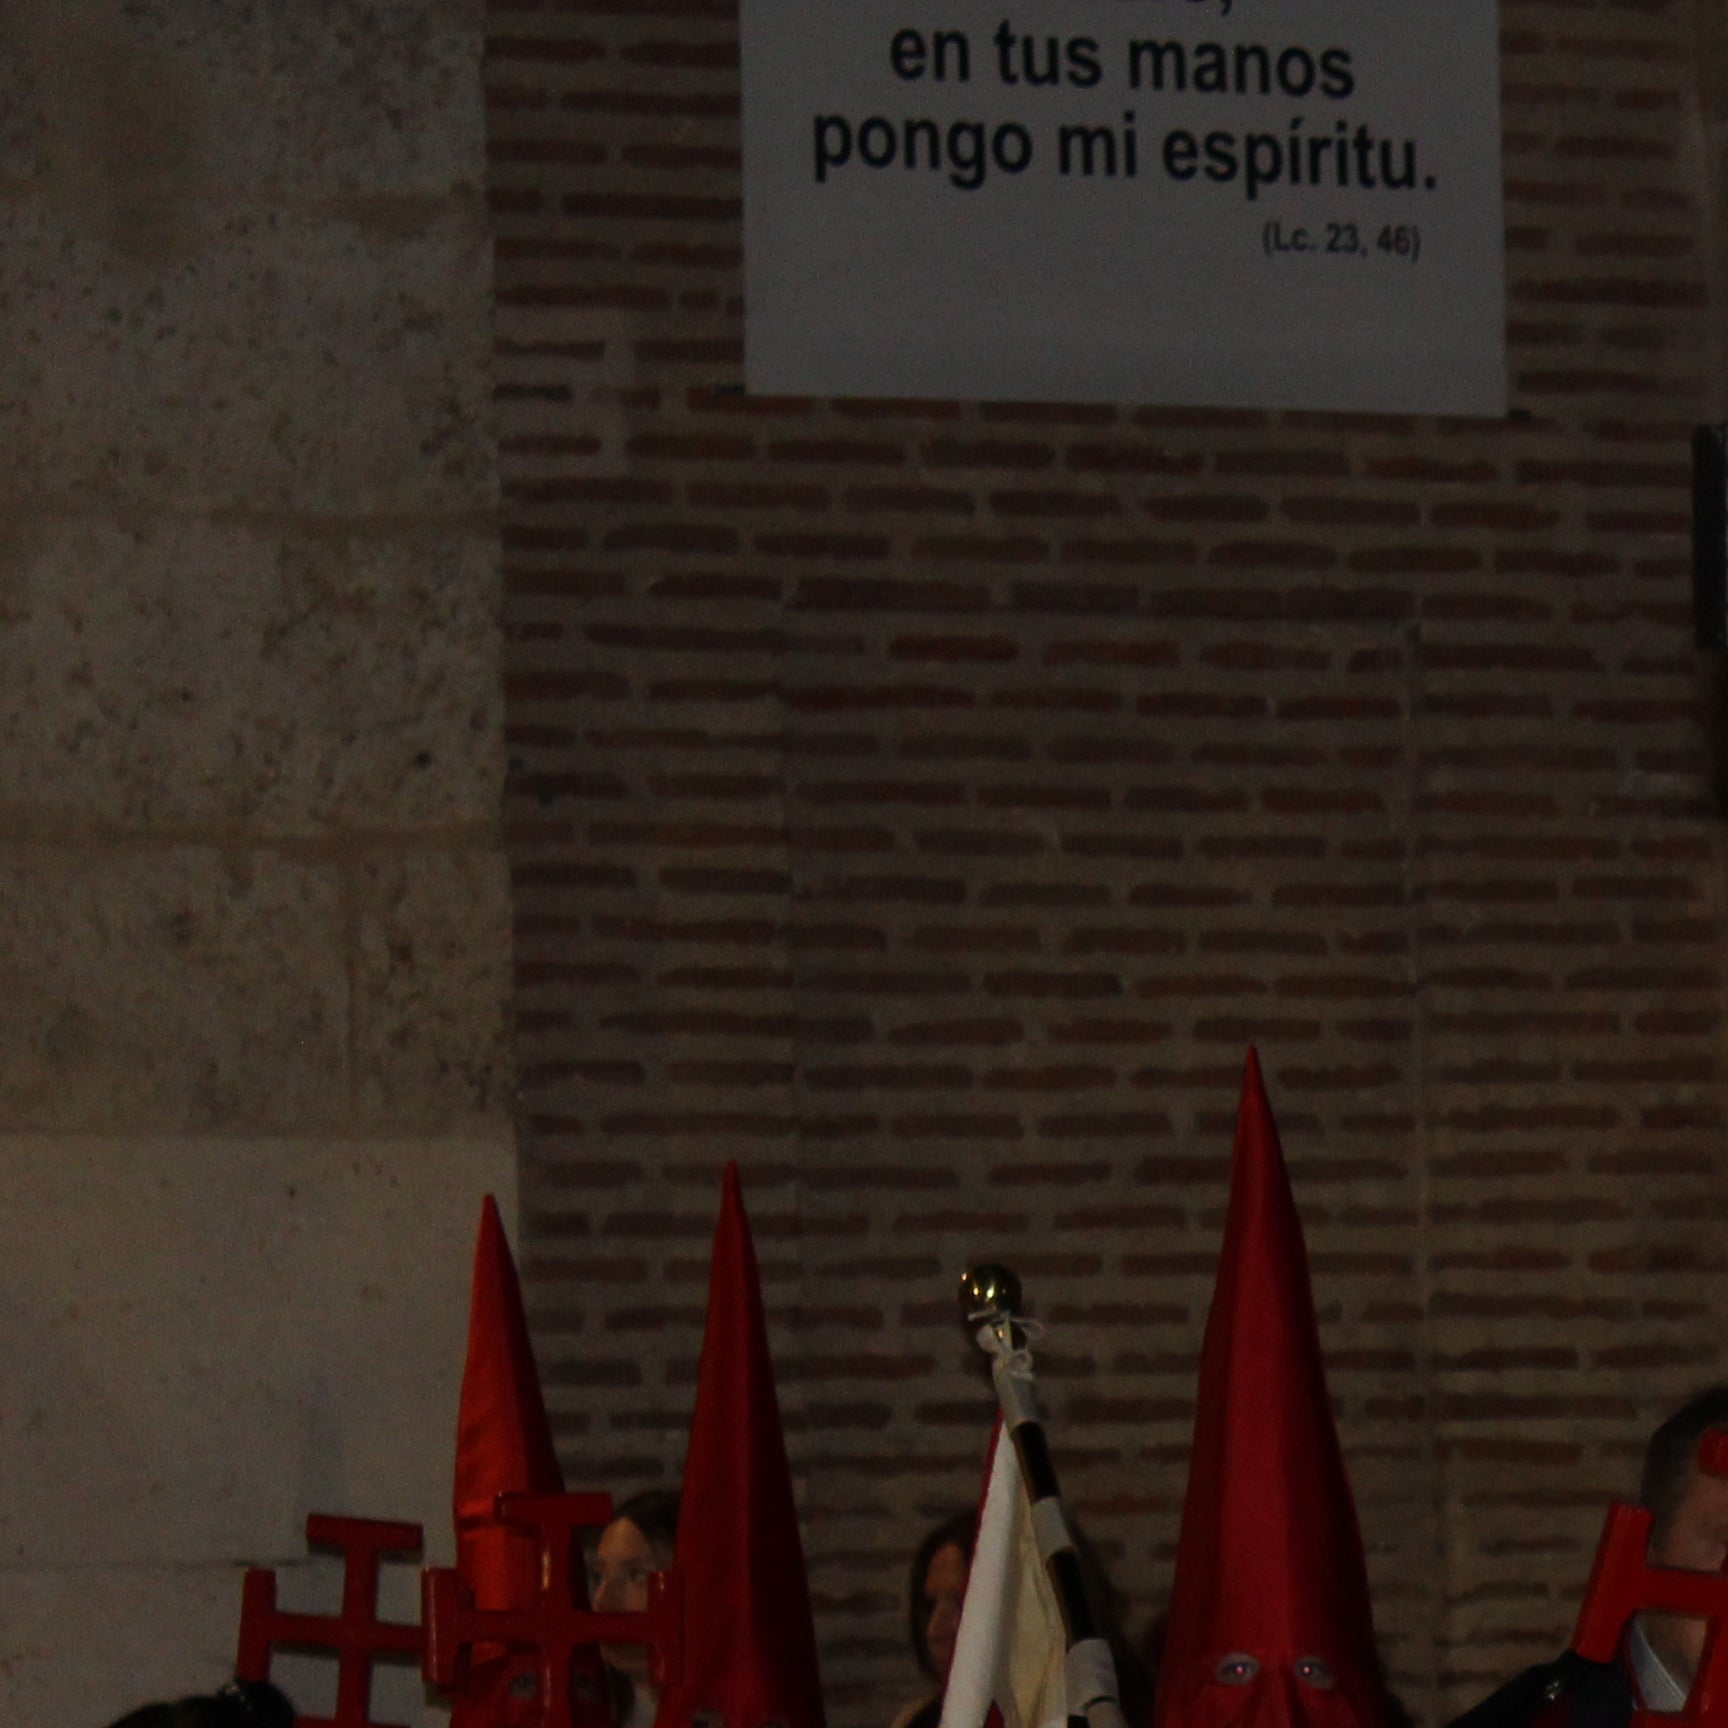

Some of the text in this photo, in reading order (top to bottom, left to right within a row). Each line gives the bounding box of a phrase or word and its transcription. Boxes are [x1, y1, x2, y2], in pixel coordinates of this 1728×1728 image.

[888, 18, 1357, 100] en tus manos
[812, 110, 1438, 203] pongo mi espíritu.
[1262, 221, 1422, 264] (Lc. 23, 46)
